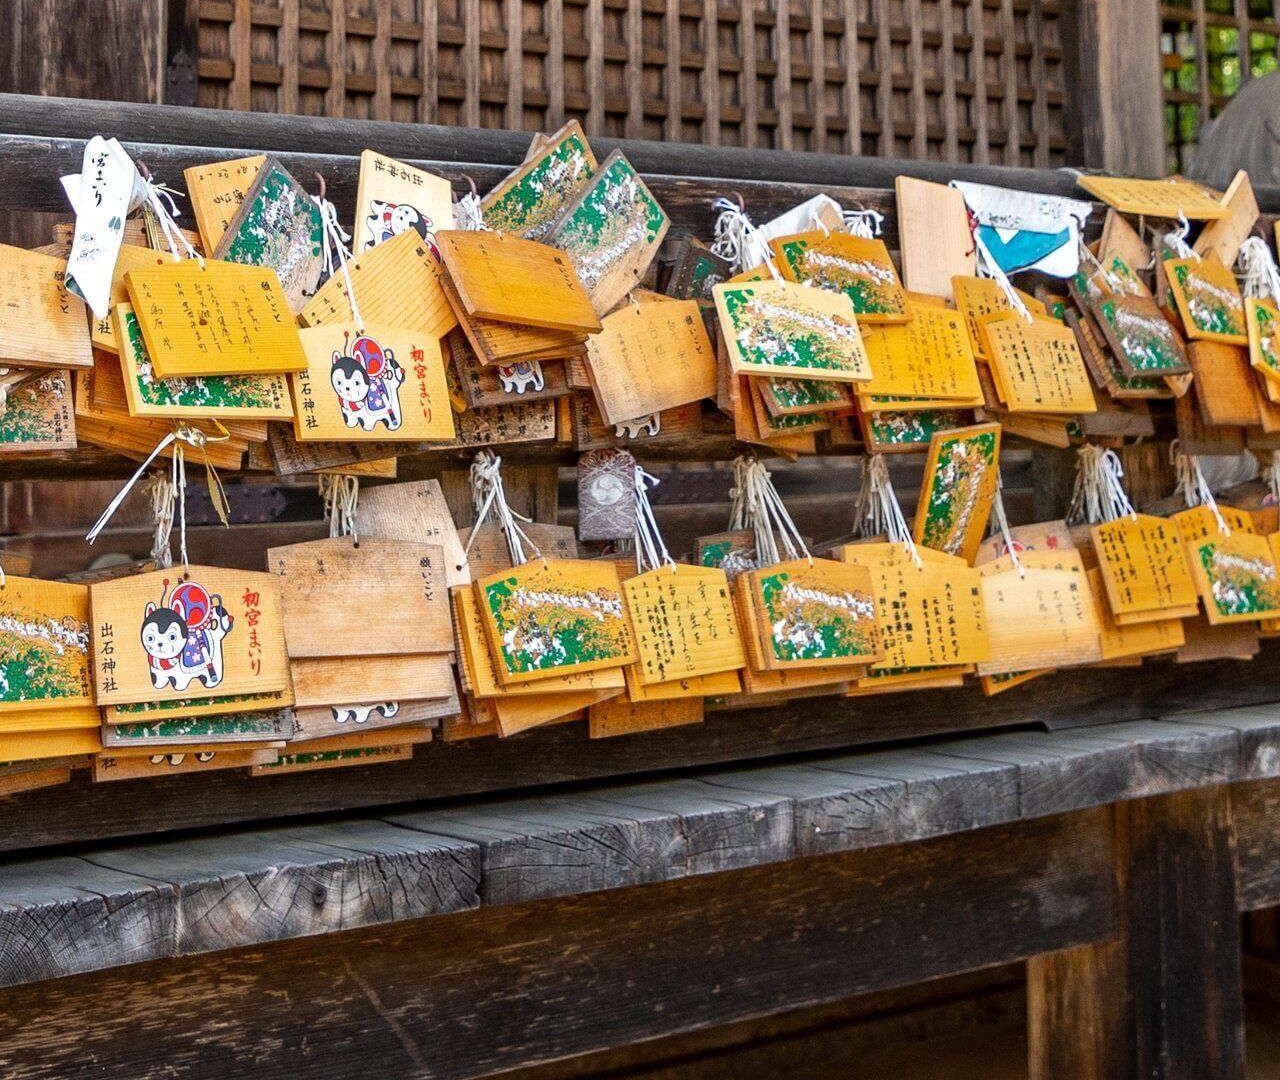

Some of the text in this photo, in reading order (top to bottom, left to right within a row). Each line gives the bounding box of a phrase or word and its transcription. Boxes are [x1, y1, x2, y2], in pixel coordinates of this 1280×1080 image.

[91, 152, 109, 208] 宮まいり
[54, 270, 70, 314] 願いごと
[260, 280, 282, 324] 願いごと
[299, 369, 319, 430] 出石神社
[409, 343, 434, 424] 初宮まいり
[419, 556, 434, 601] 願いごと
[241, 587, 262, 676] 初宮まいり
[719, 588, 735, 635] 願いごと
[971, 587, 982, 631] 願いごと
[100, 622, 119, 693] 出石神社
